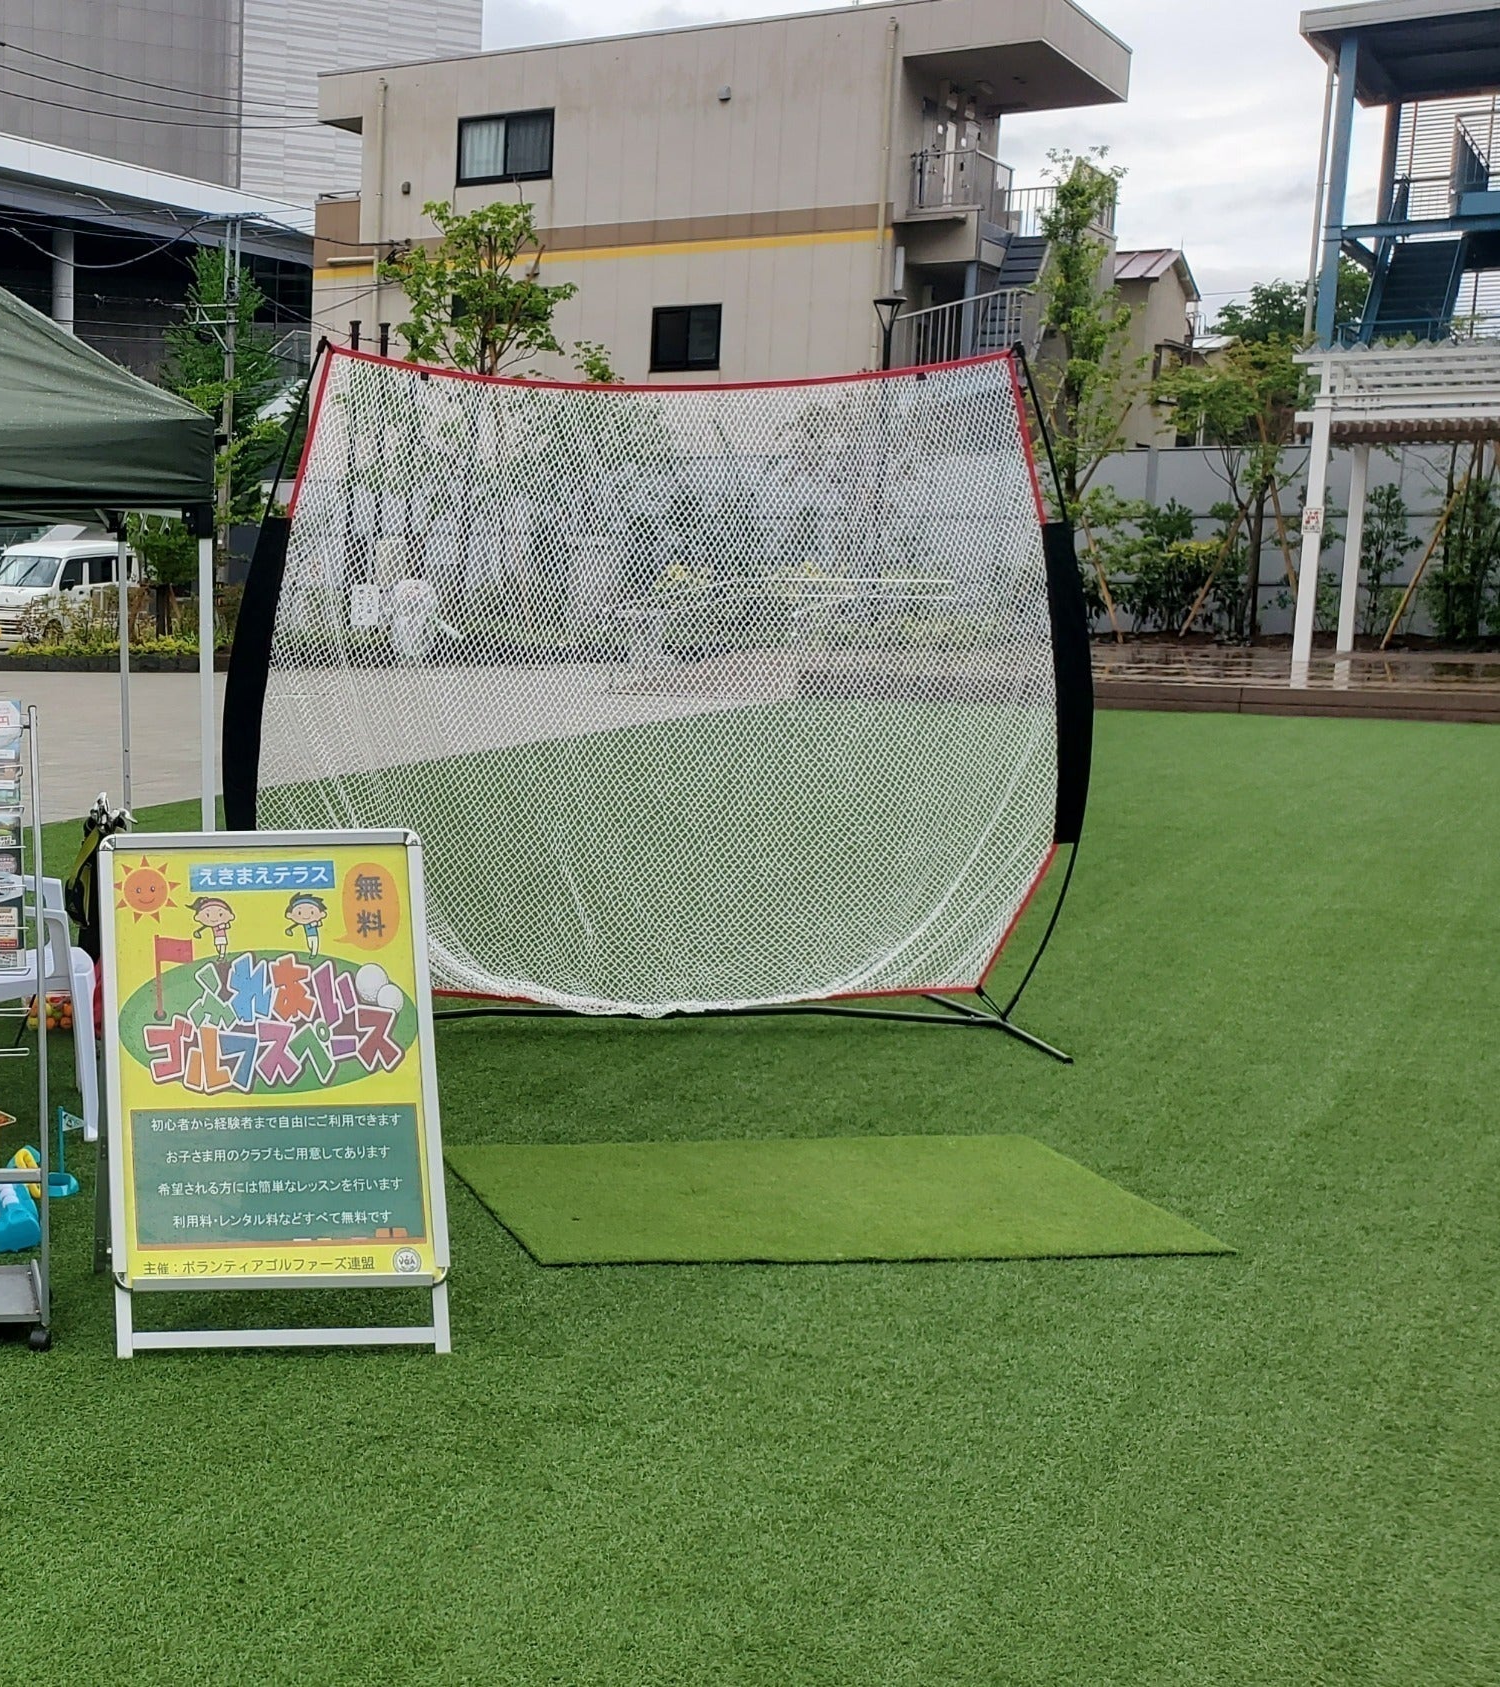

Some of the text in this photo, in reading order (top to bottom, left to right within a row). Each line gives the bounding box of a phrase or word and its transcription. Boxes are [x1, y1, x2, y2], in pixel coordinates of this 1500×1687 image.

[199, 865, 329, 887] えきまえテラス
[355, 874, 386, 938] 無料
[188, 953, 356, 1030] ふれあい
[144, 1005, 404, 1092] ゴルフスペース
[151, 1113, 402, 1131] 初心者から経験者まで自由にご利用できます
[166, 1146, 391, 1164] お子さま用のクラブもご用意してあります
[157, 1178, 403, 1197] 希望される方には簡単なレッスンを行います
[172, 1210, 392, 1229] 利用料・レンタル料などすべて無料です
[144, 1256, 375, 1276] 主催：ボランティアゴルファーズ連盟
